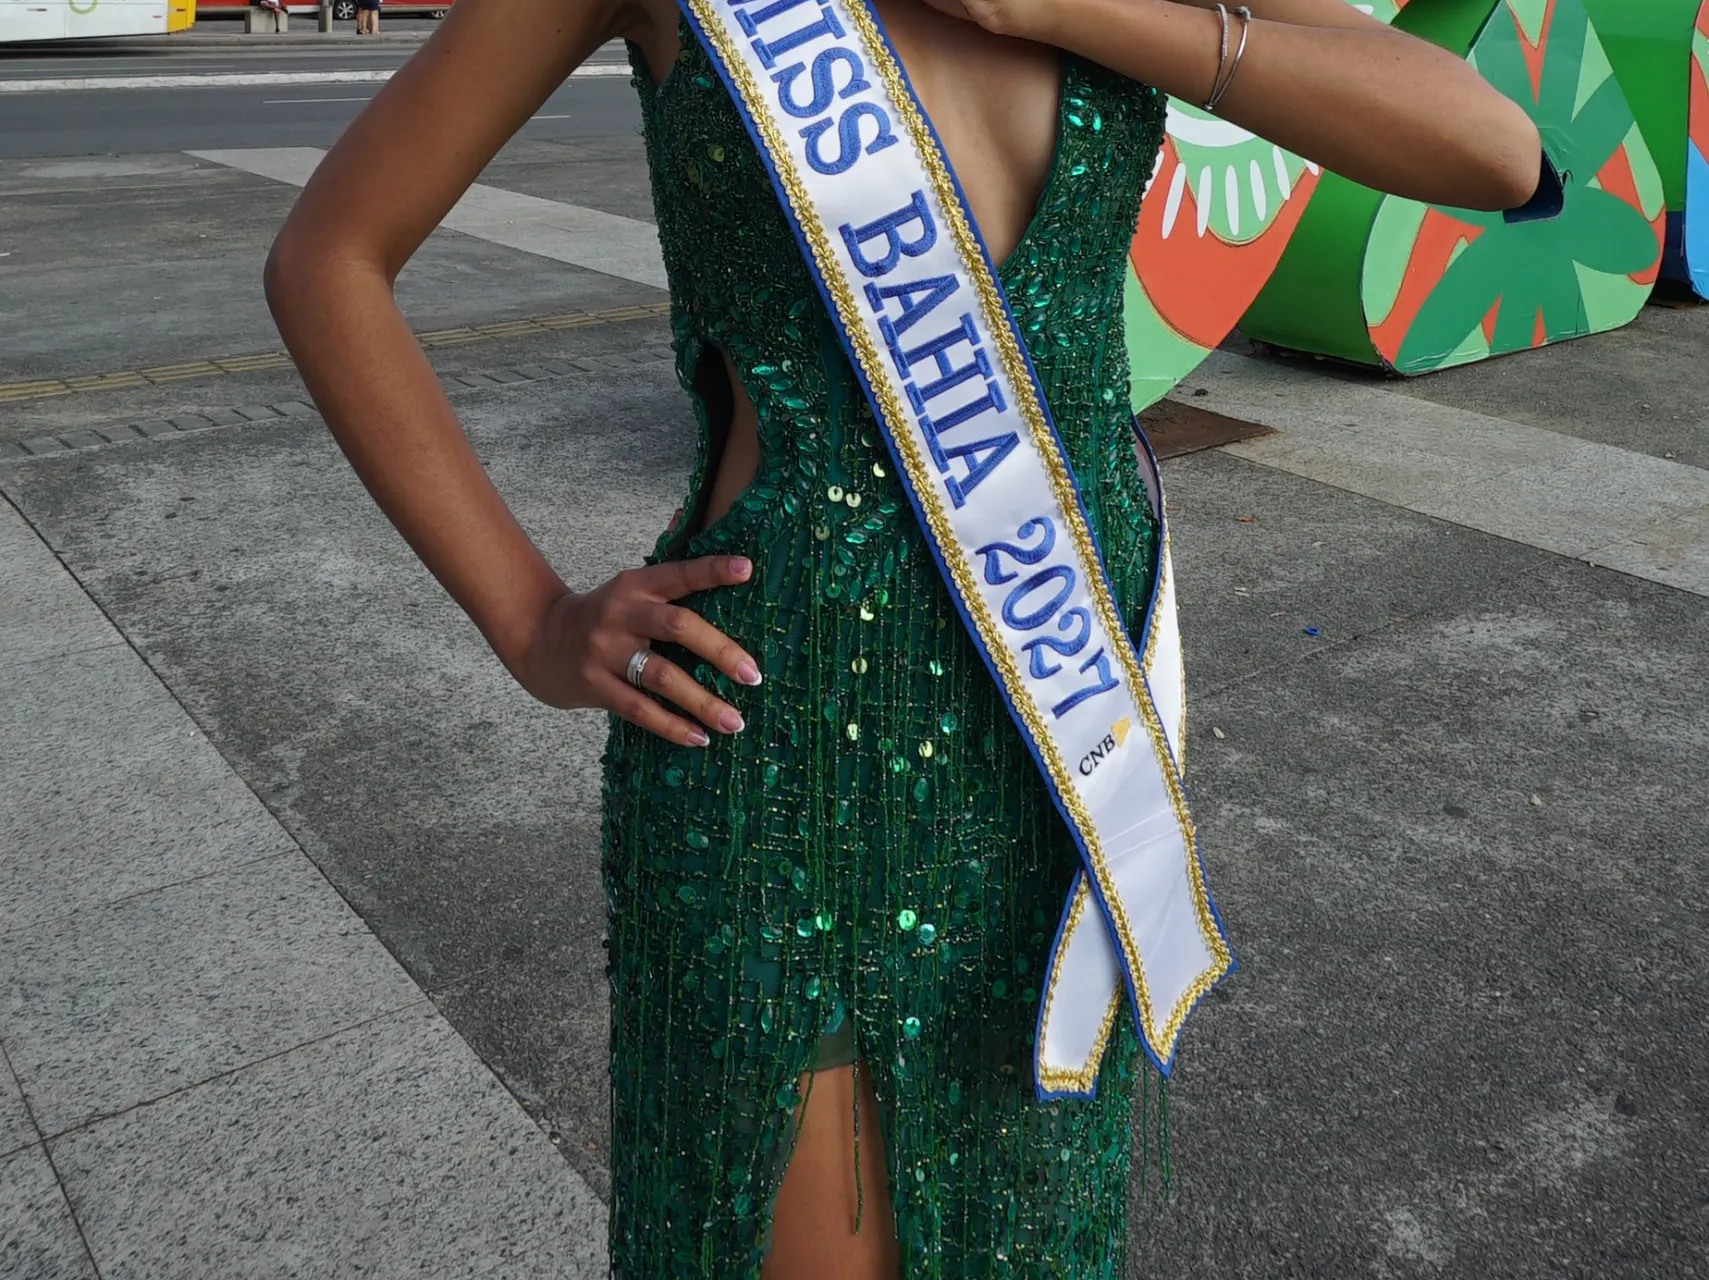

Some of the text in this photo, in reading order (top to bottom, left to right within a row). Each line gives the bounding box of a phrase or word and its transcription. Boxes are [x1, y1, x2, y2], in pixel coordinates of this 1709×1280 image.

[839, 189, 1020, 510] BAHIA
[975, 515, 1120, 720] 2027
[1078, 733, 1116, 777] CNB
